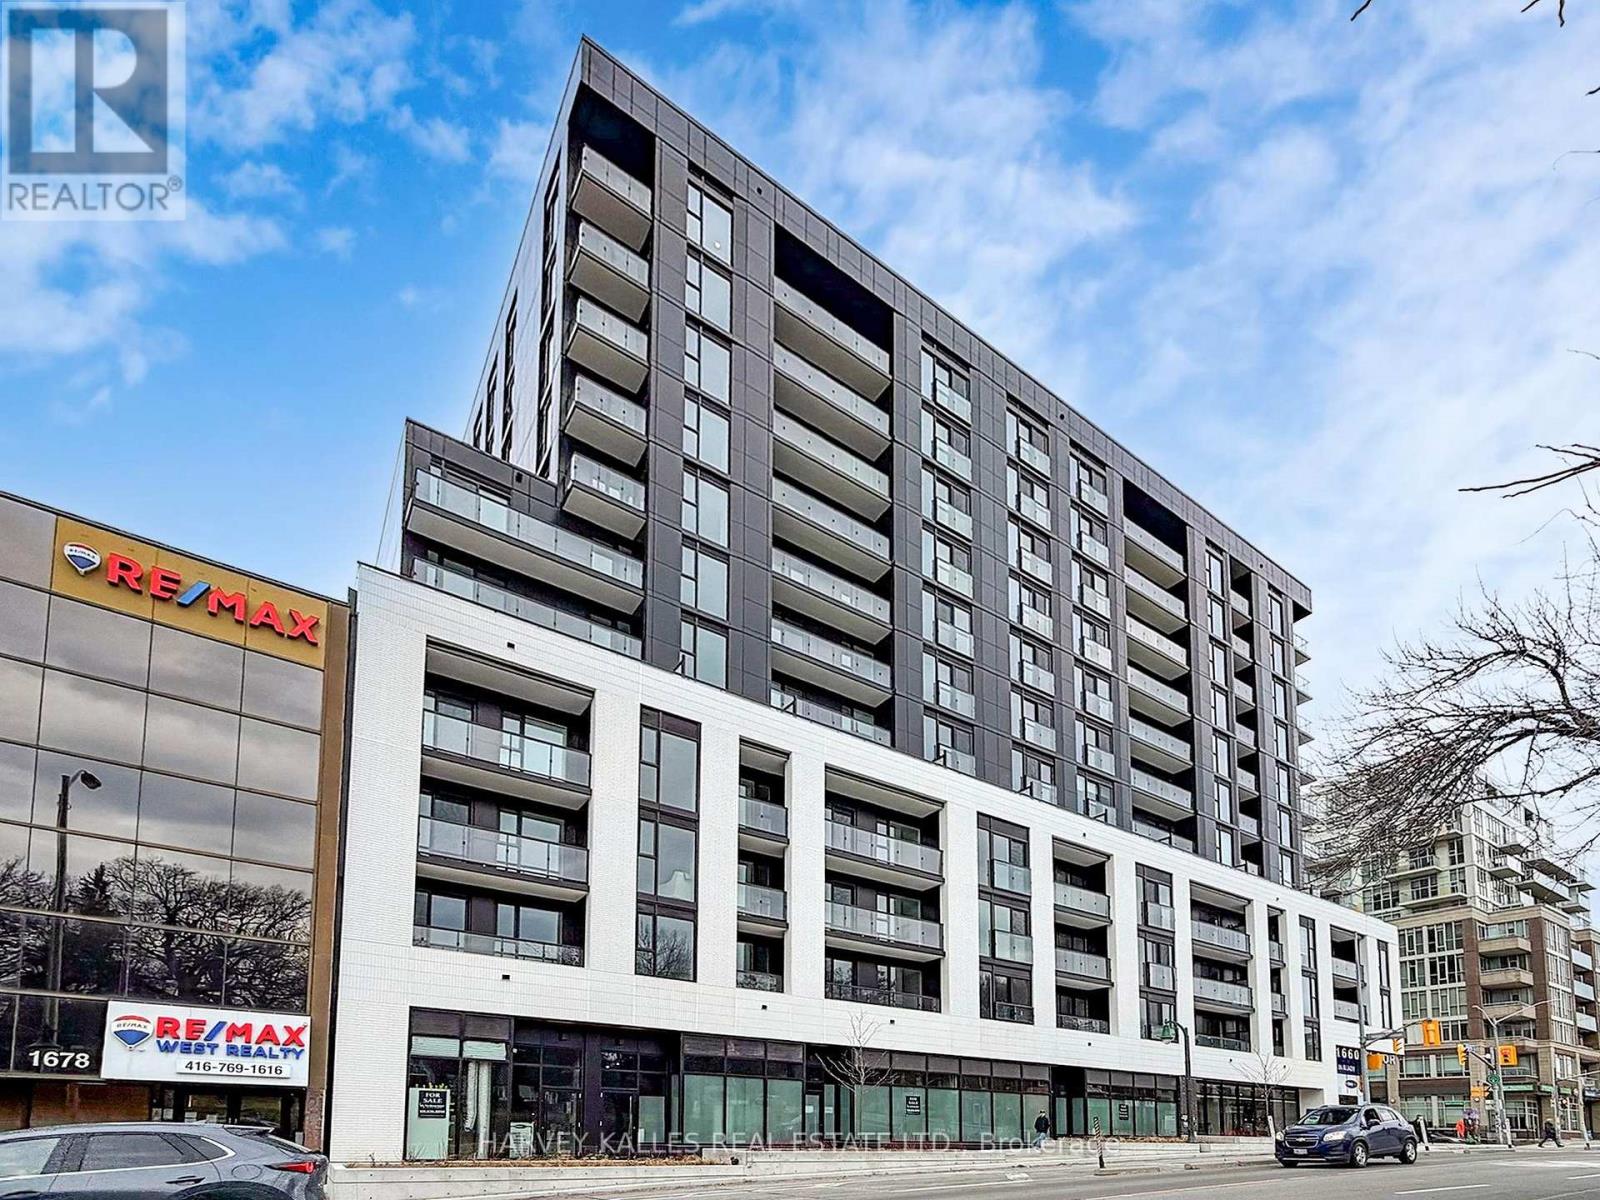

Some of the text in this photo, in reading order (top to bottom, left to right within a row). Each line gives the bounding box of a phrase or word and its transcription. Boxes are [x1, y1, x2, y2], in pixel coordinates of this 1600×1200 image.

[106, 552, 320, 646] RE/MAX
[156, 1016, 306, 1047] RE/MAX
[29, 1050, 91, 1069] 1678
[156, 1040, 305, 1060] WEST REALTY
[1336, 1047, 1360, 1060] 1660
[185, 1061, 283, 1075] 416-769-1616
